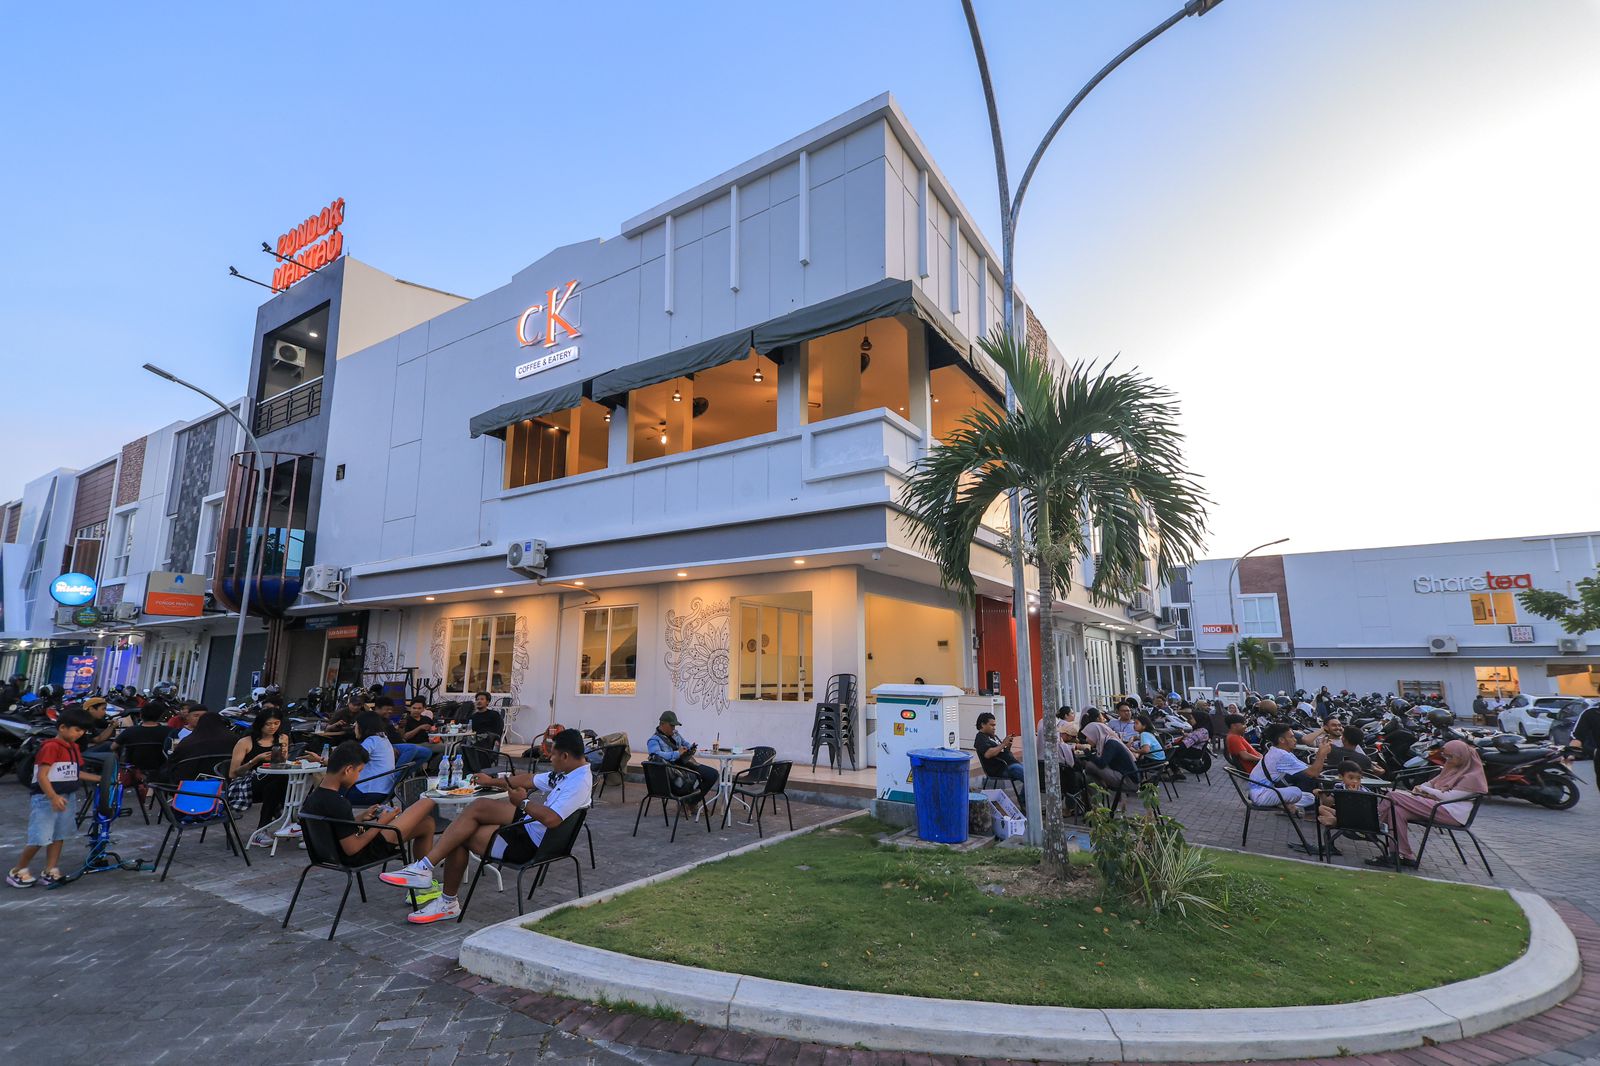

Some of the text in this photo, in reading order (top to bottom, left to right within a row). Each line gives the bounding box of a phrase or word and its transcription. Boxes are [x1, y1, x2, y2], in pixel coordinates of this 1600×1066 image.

[276, 197, 345, 262] PONDOK
[271, 230, 343, 294] MANTAU
[517, 349, 573, 375] COFFEE & EATERY
